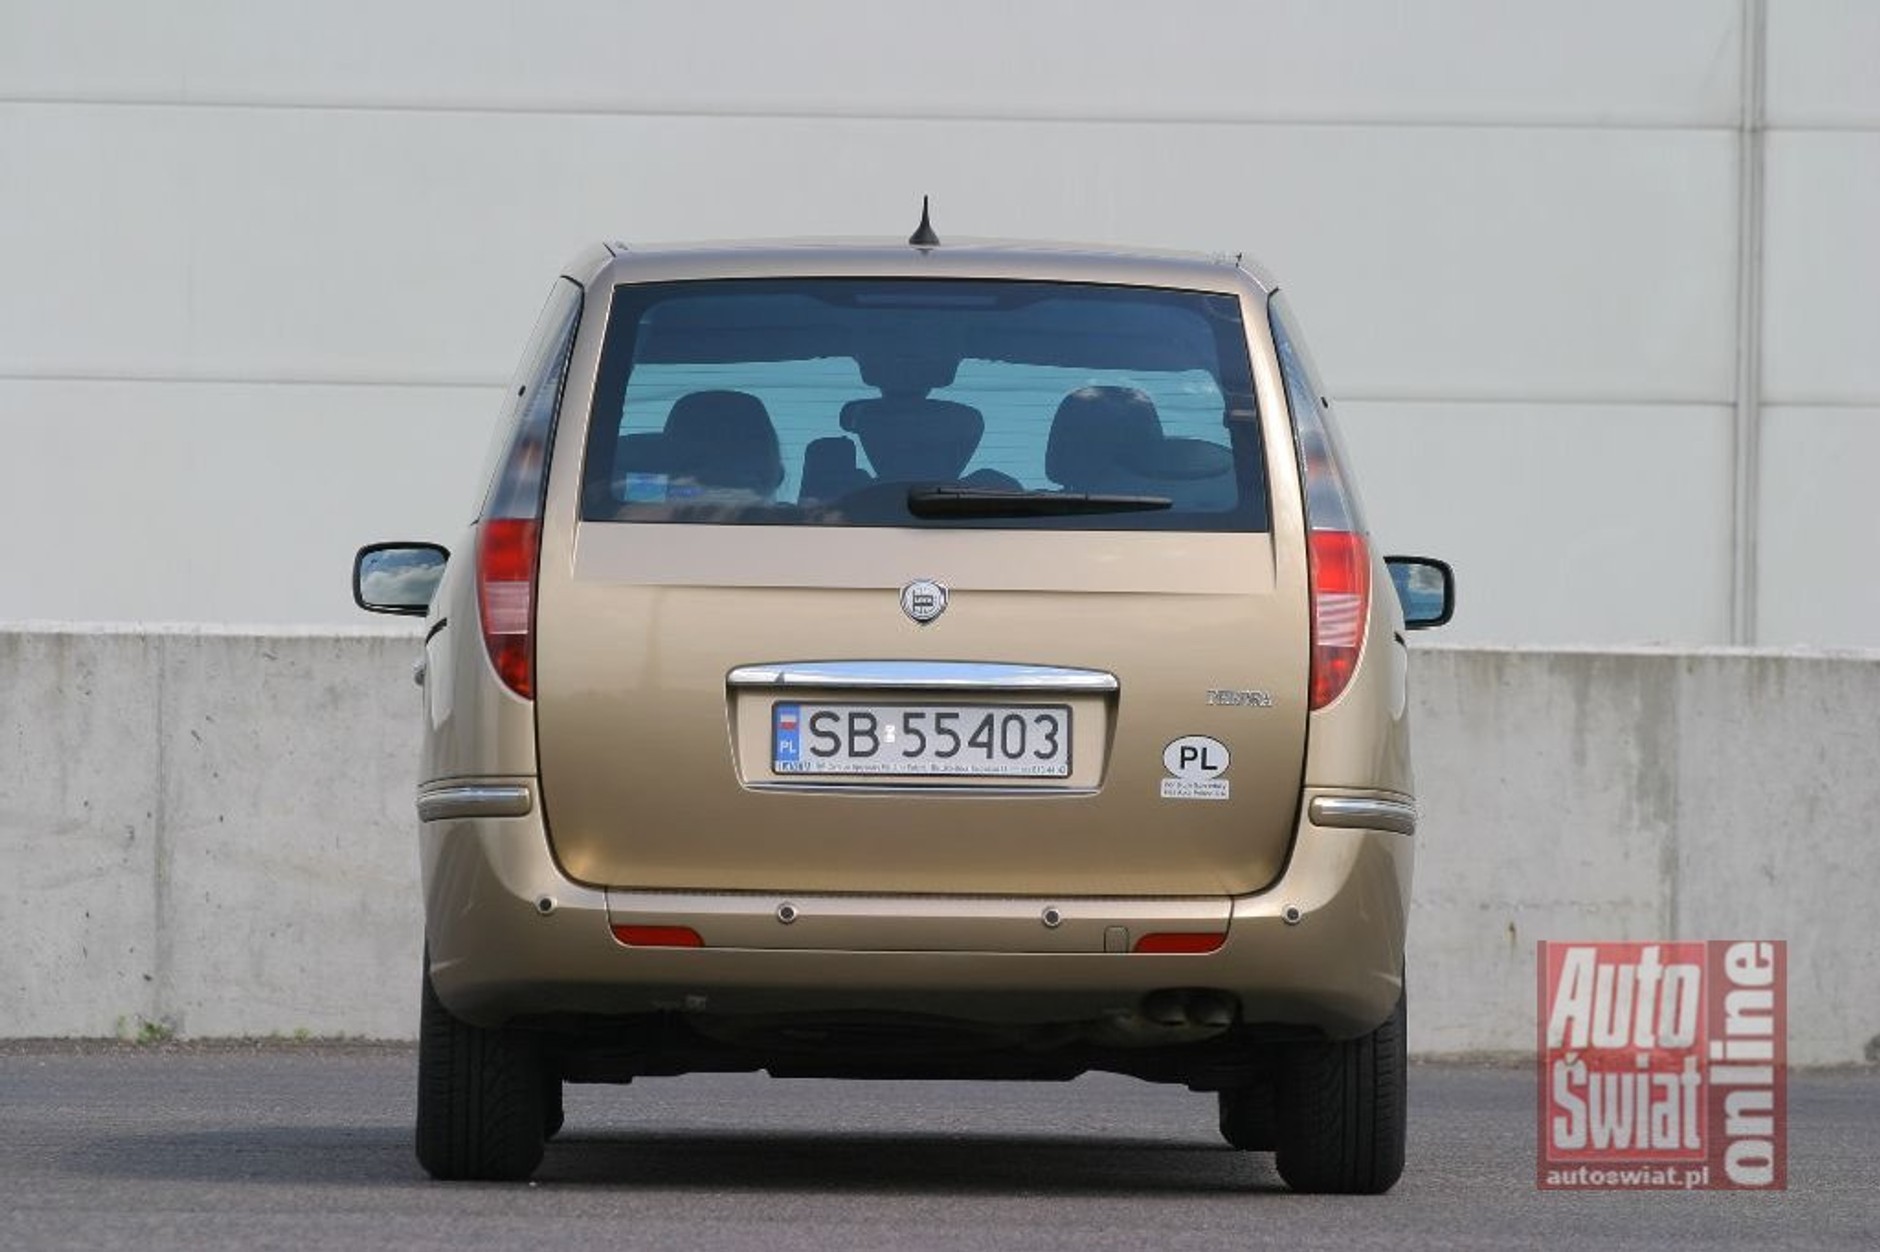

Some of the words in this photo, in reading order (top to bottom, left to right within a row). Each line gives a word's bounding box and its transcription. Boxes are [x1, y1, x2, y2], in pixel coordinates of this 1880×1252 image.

[780, 740, 797, 753] PL
[809, 711, 880, 758] SB
[902, 712, 1059, 760] 55403
[1180, 745, 1218, 770] PL
